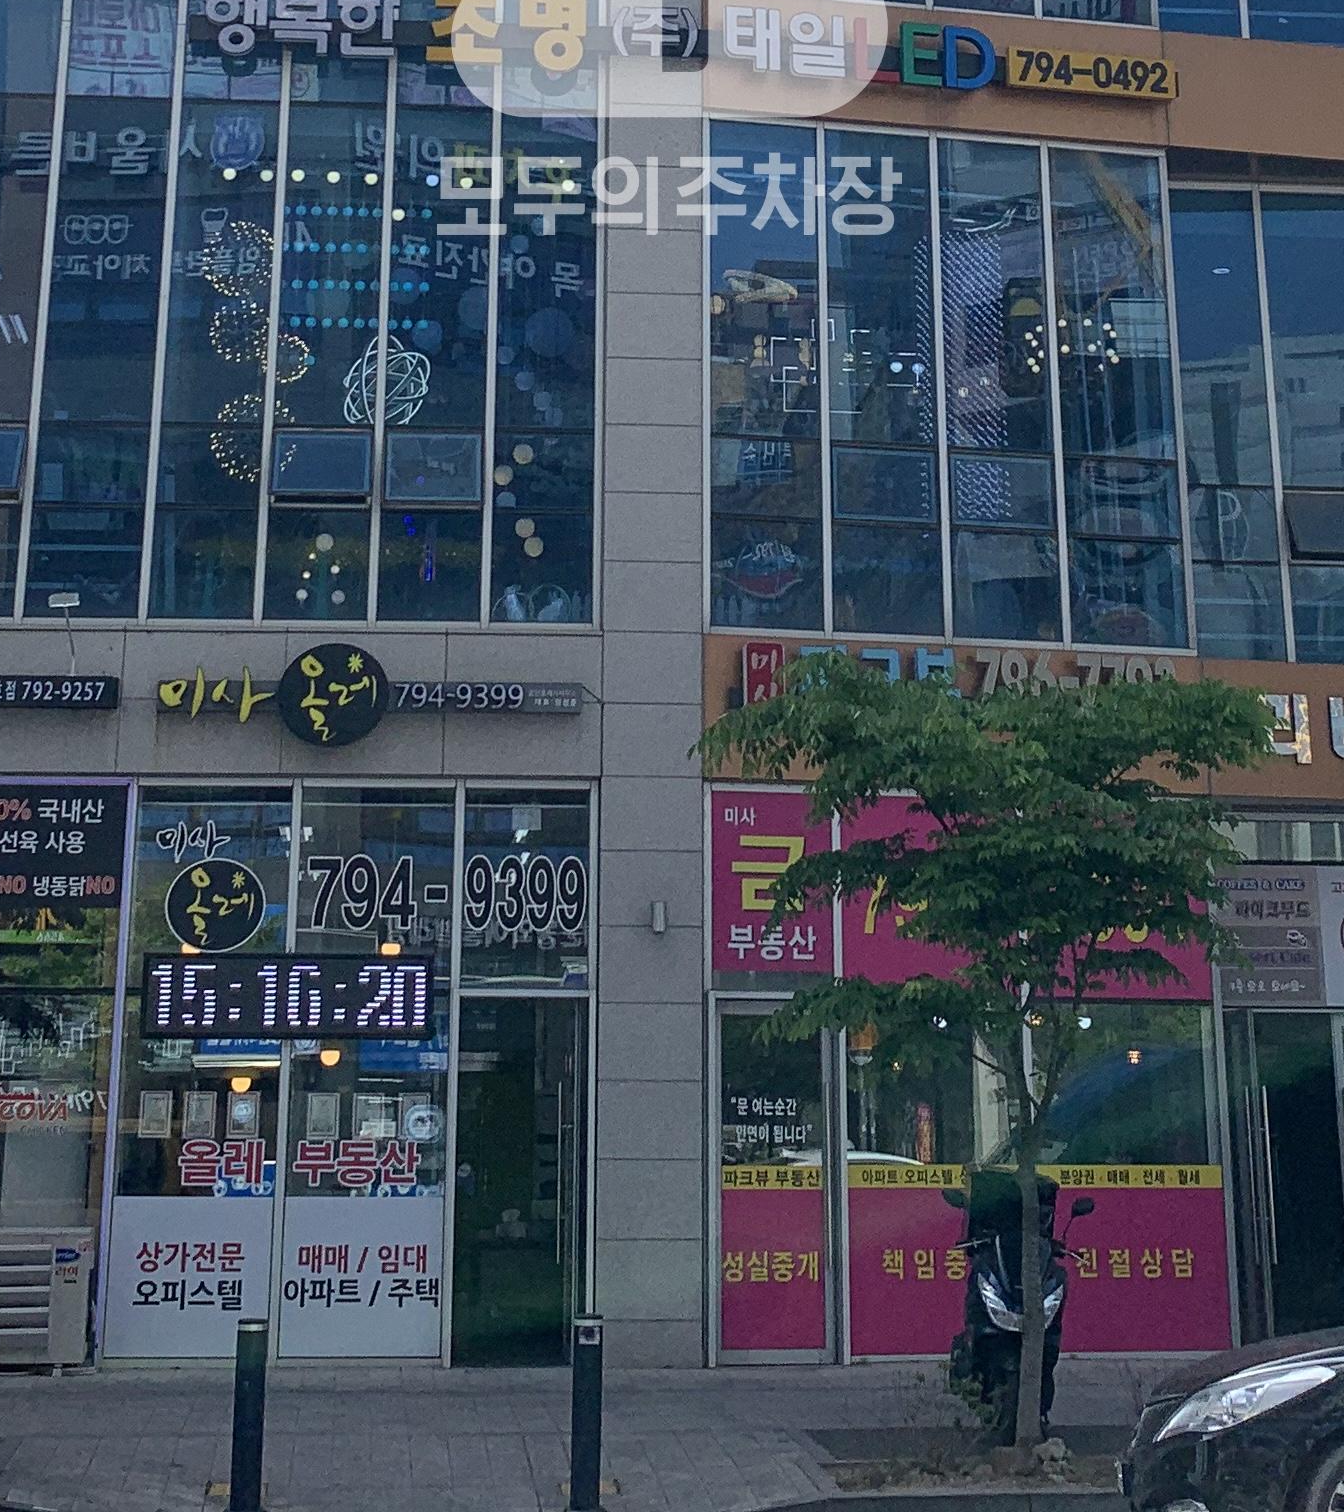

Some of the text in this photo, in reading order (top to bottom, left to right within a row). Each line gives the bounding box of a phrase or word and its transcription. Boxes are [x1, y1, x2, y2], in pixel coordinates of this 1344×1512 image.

[1016, 49, 1169, 93] 794-0492
[21, 679, 105, 703] 792-9257
[158, 665, 276, 724] 미사
[395, 682, 525, 710] 794-9399
[36, 798, 105, 825] 국내산
[724, 806, 757, 826] 미사
[45, 830, 86, 855] 사용
[156, 820, 231, 863] 미사
[728, 924, 817, 961] 부동산
[152, 964, 428, 1028] 15:16:20
[177, 1139, 422, 1187] 올레 부동산
[723, 1169, 821, 1187] 파크뷰 부동산
[862, 1169, 954, 1186] 아파트 오피스텔
[1060, 1169, 1096, 1186] 분양권
[1107, 1169, 1131, 1186] 매매
[1142, 1169, 1166, 1186] 전세
[136, 1241, 246, 1273] 상가전문
[298, 1244, 350, 1274] 매매
[378, 1245, 428, 1274] 임대
[723, 1250, 819, 1283] 성실중개
[133, 1280, 244, 1311] 오피스텔
[283, 1278, 361, 1308] 아파트
[388, 1278, 441, 1308] 주택
